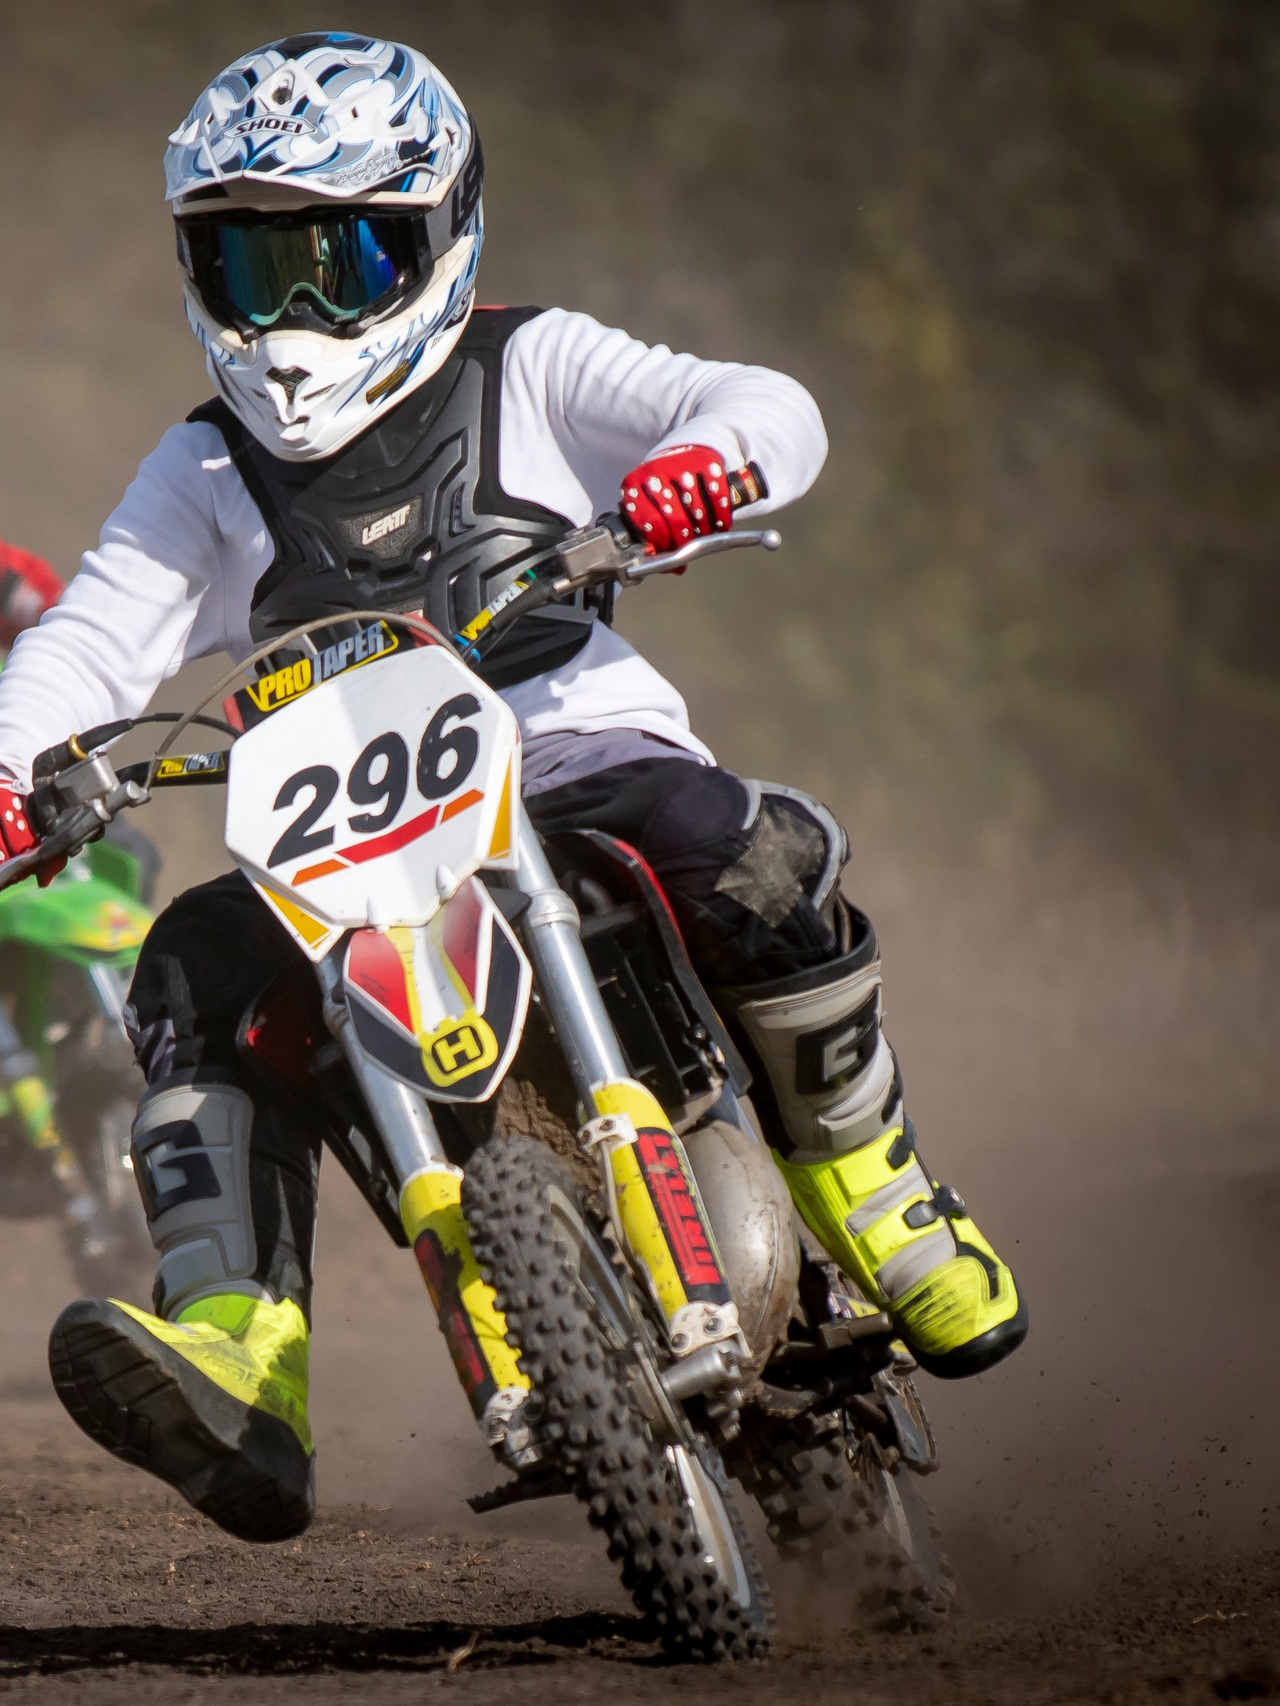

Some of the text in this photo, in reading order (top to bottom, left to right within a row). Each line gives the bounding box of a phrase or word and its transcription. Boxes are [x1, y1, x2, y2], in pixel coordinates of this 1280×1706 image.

[234, 117, 303, 136] SHOEI
[362, 504, 411, 546] LEATT
[266, 693, 484, 869] 296
